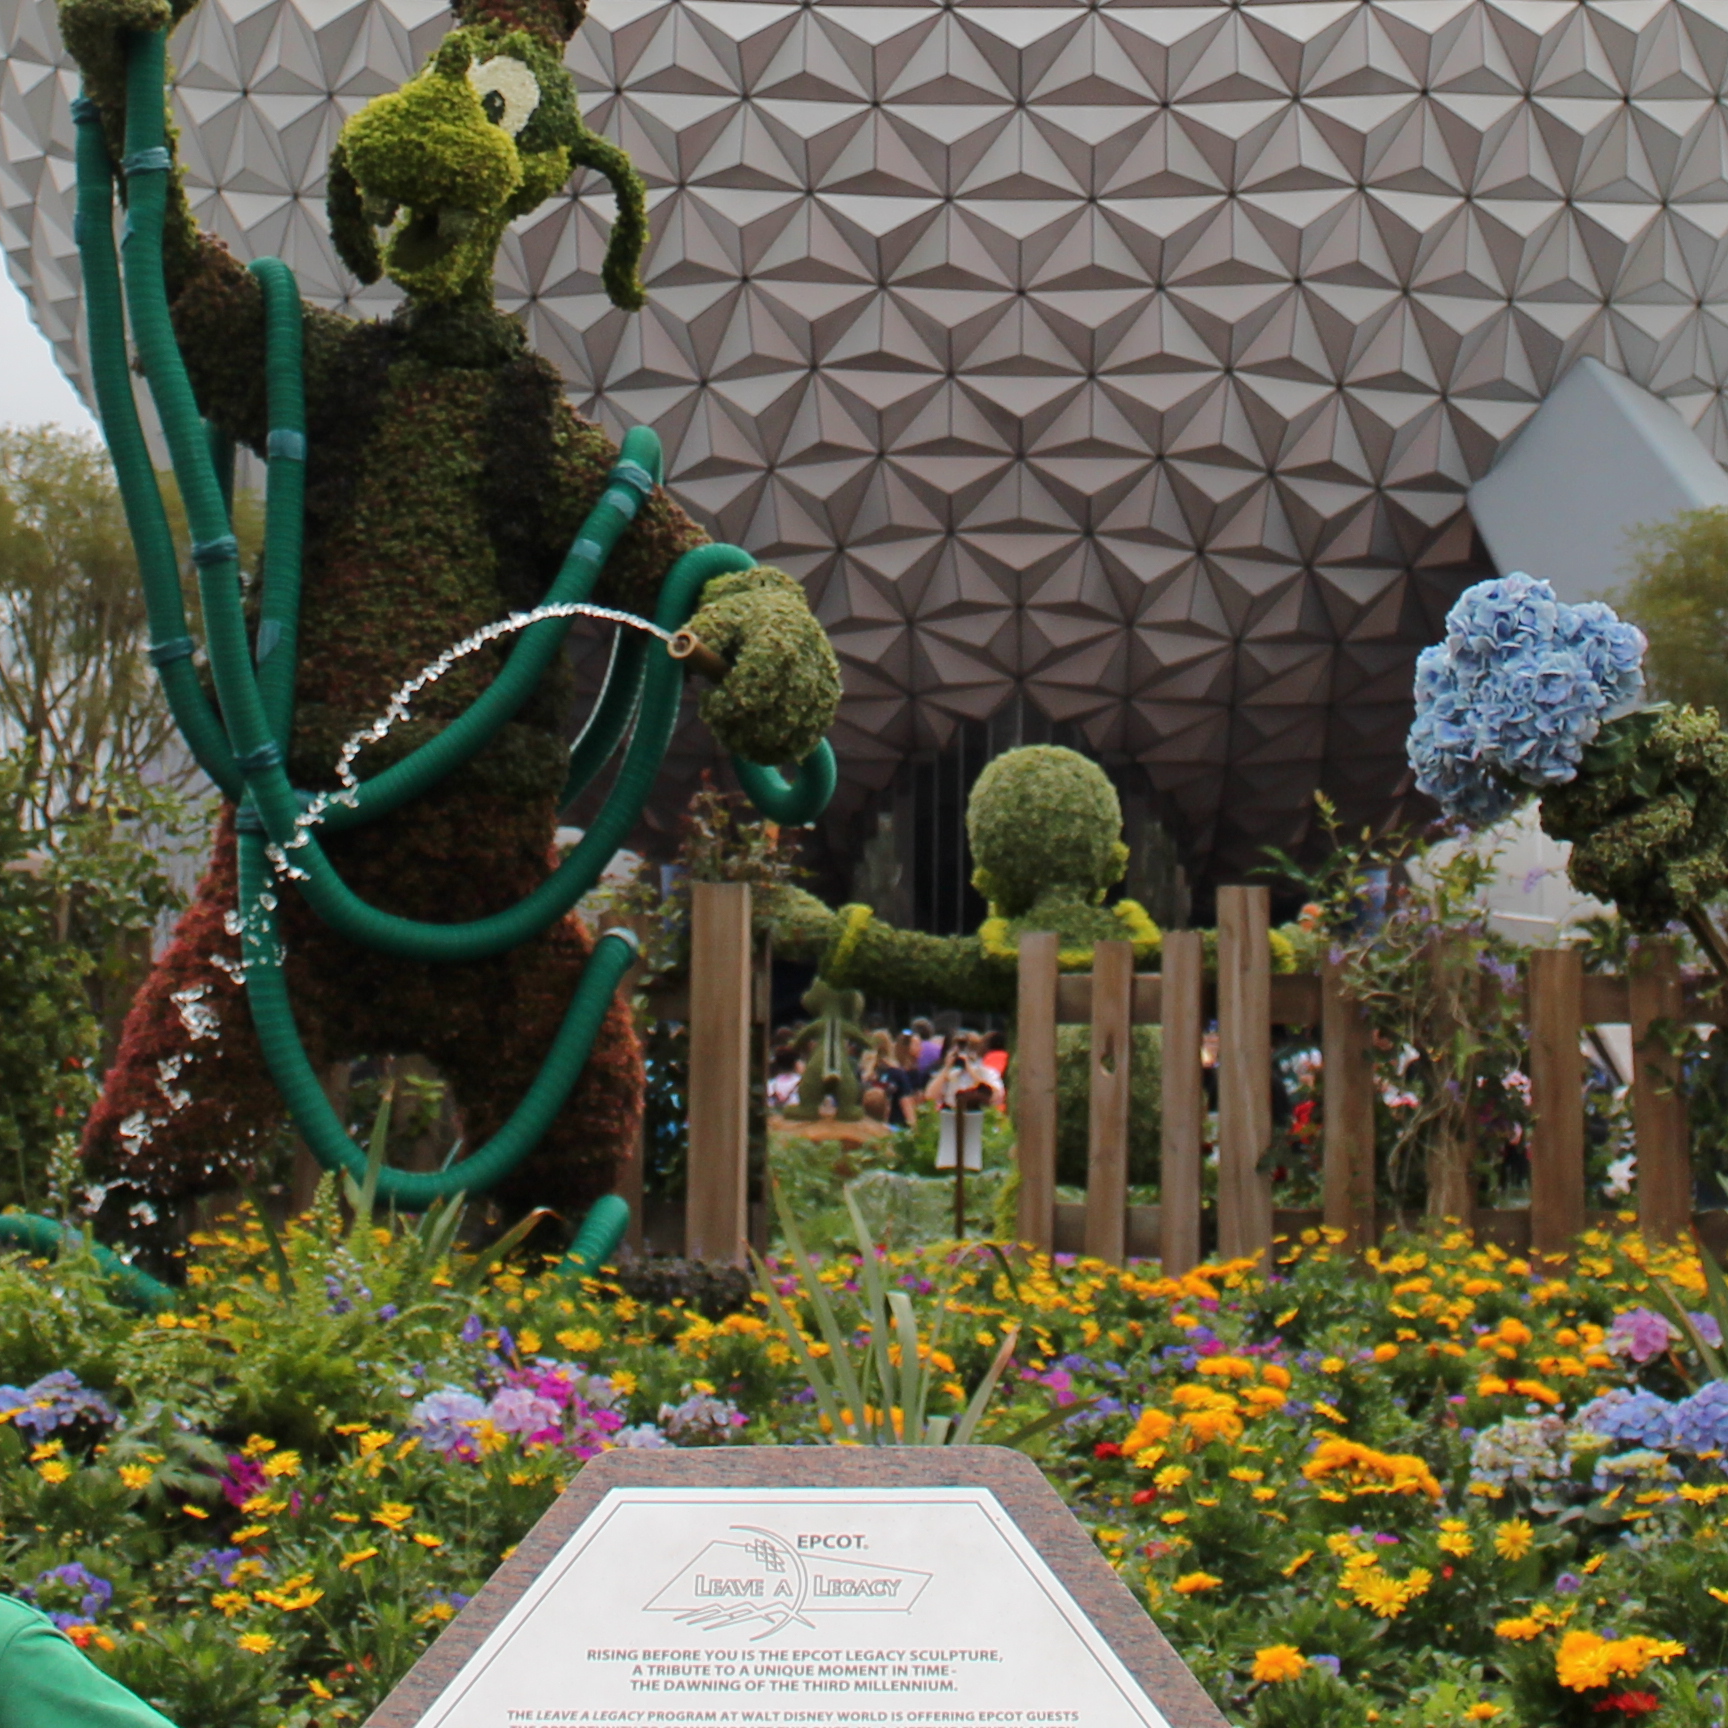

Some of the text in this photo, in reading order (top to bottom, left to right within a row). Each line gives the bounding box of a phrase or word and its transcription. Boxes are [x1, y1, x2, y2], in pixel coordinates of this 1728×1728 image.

[694, 1574, 902, 1597] LEAVE A LEGACY
[587, 1649, 1003, 1663] RISING BEFORE YOU IS THE EPCOT LEGACY SCULPTURE,
[632, 1664, 643, 1677] A
[647, 1664, 710, 1677] TRIBUTE
[715, 1664, 735, 1677] TO
[739, 1664, 750, 1677] A
[754, 1664, 814, 1677] UNIQUE
[818, 1664, 888, 1677] MOMENT
[892, 1664, 908, 1677] IN
[630, 1679, 958, 1692] THE DAWNING OF THE THIRD MILLENNIUM.
[507, 1710, 1079, 1722] THE LEAVE A LEGACY PROGRAM AT WALT DISNEY WORLD IS OFFERING EPCOT GUESTS
